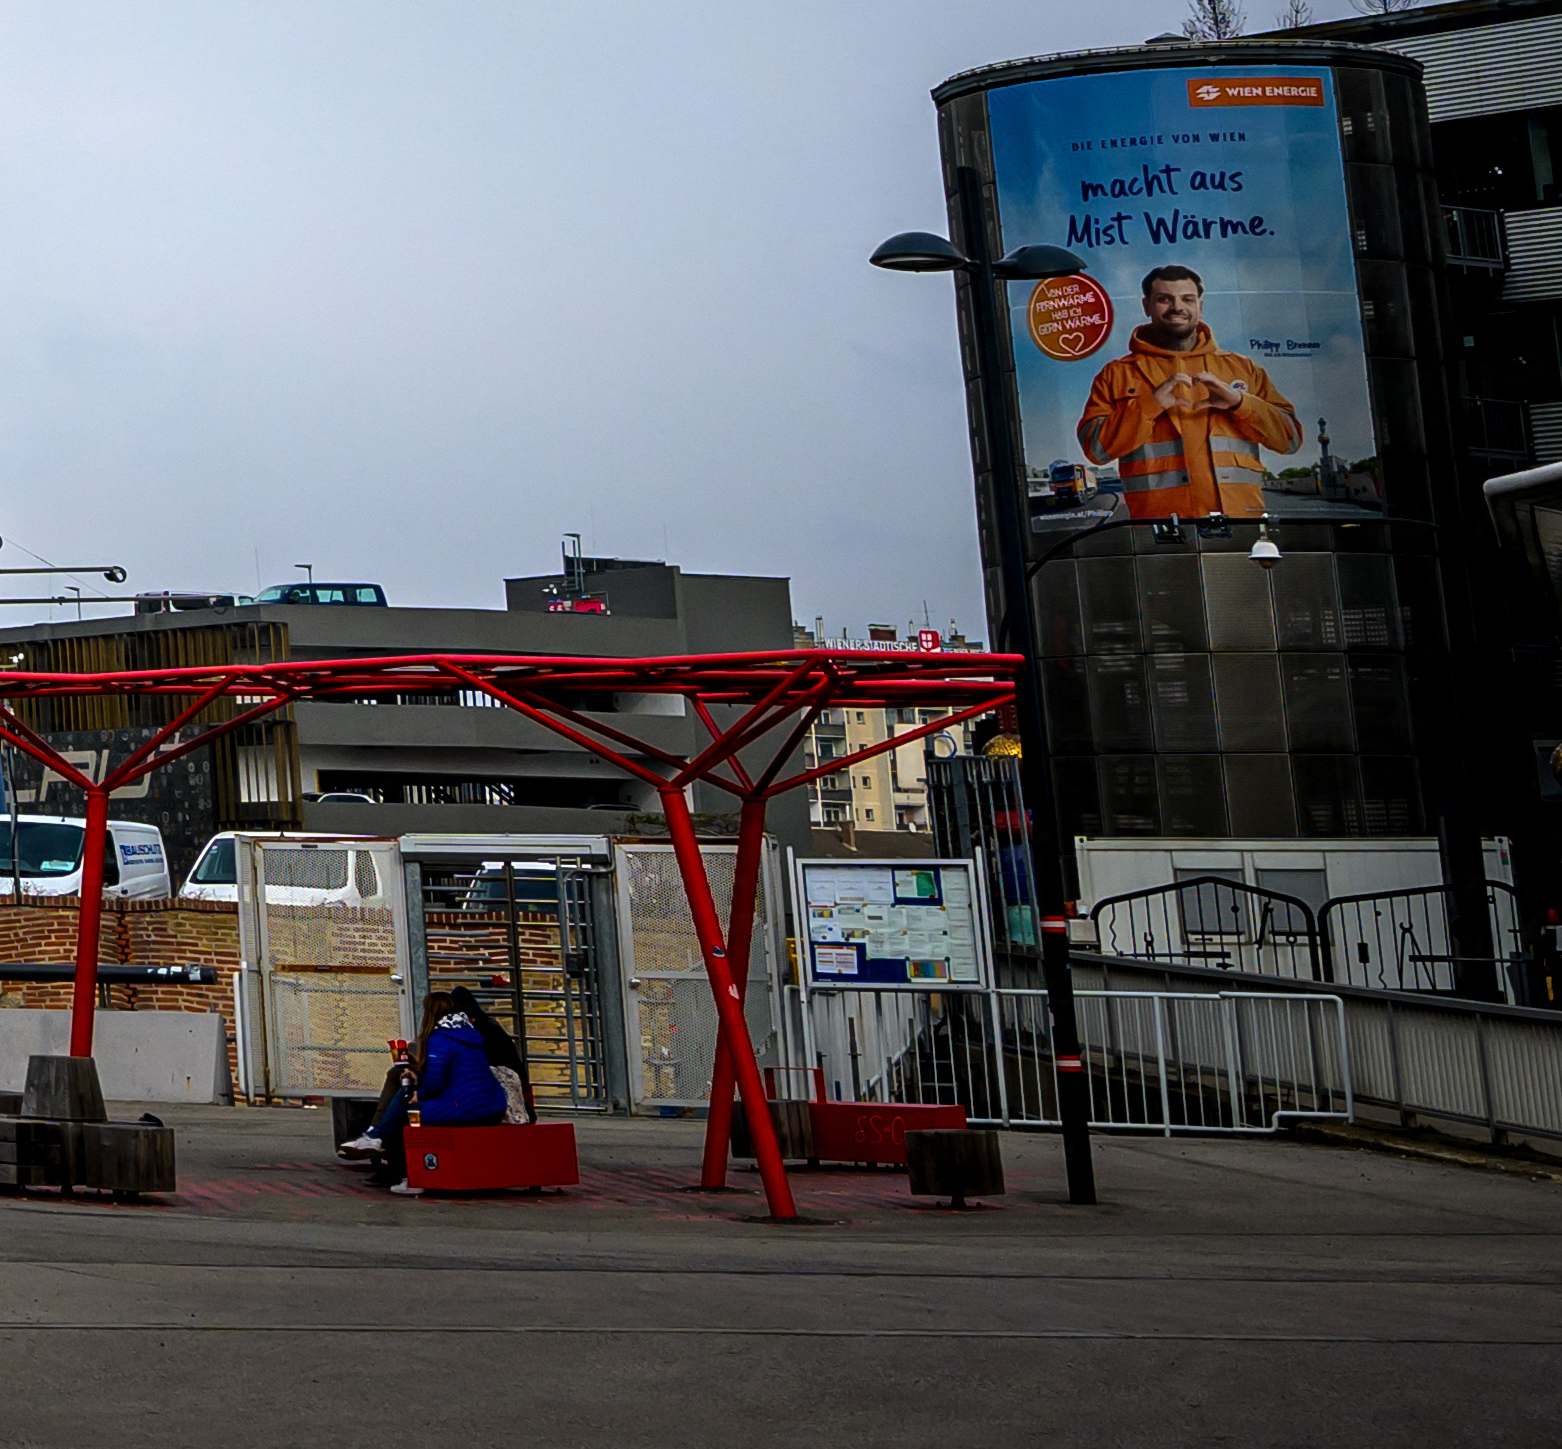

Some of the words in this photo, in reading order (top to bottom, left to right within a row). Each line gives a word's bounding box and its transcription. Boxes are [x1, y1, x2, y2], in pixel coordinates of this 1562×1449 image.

[1225, 86, 1263, 97] WIEN
[1265, 86, 1318, 97] ENERGIE
[1072, 140, 1093, 151] DIE
[1100, 134, 1164, 149] ENERGIE
[1172, 133, 1200, 144] VON
[1208, 131, 1246, 143] WIEN
[1080, 163, 1182, 203] macht
[1189, 170, 1244, 193] aus
[1066, 211, 1133, 248] Mist
[1143, 208, 1276, 245] Wärme.
[1063, 284, 1080, 295] DER
[1051, 309, 1069, 320] HAB
